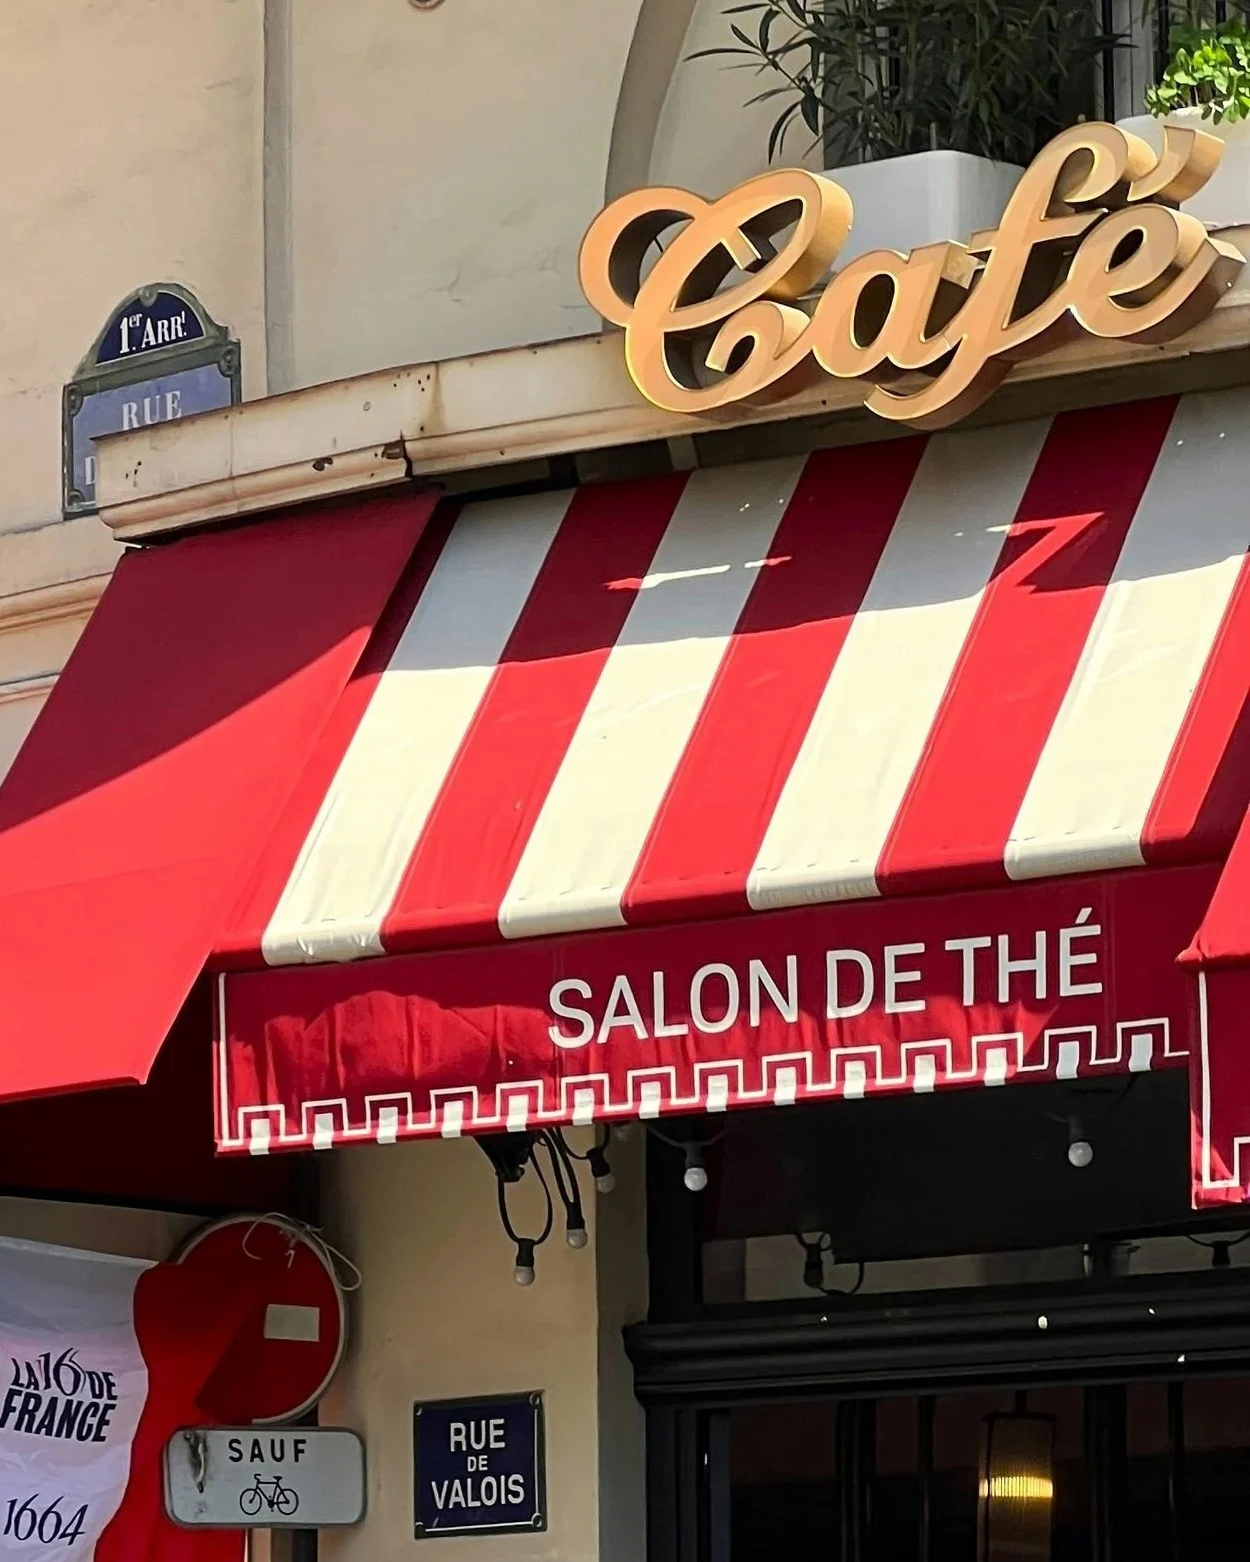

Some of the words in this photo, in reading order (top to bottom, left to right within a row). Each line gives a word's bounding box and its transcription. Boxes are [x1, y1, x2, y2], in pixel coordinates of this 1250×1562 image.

[578, 120, 1245, 430] Café
[122, 391, 182, 430] RUE
[548, 954, 799, 1049] SALON
[826, 949, 926, 1020] DE
[944, 907, 1103, 1007] THÉ
[10, 1357, 40, 1391] LA
[86, 1370, 119, 1401] DE
[228, 1438, 307, 1464] SAUF
[450, 1418, 506, 1452] RUE
[467, 1455, 489, 1472] DE
[431, 1474, 525, 1510] VALOIS
[3, 1493, 89, 1546] 1664
